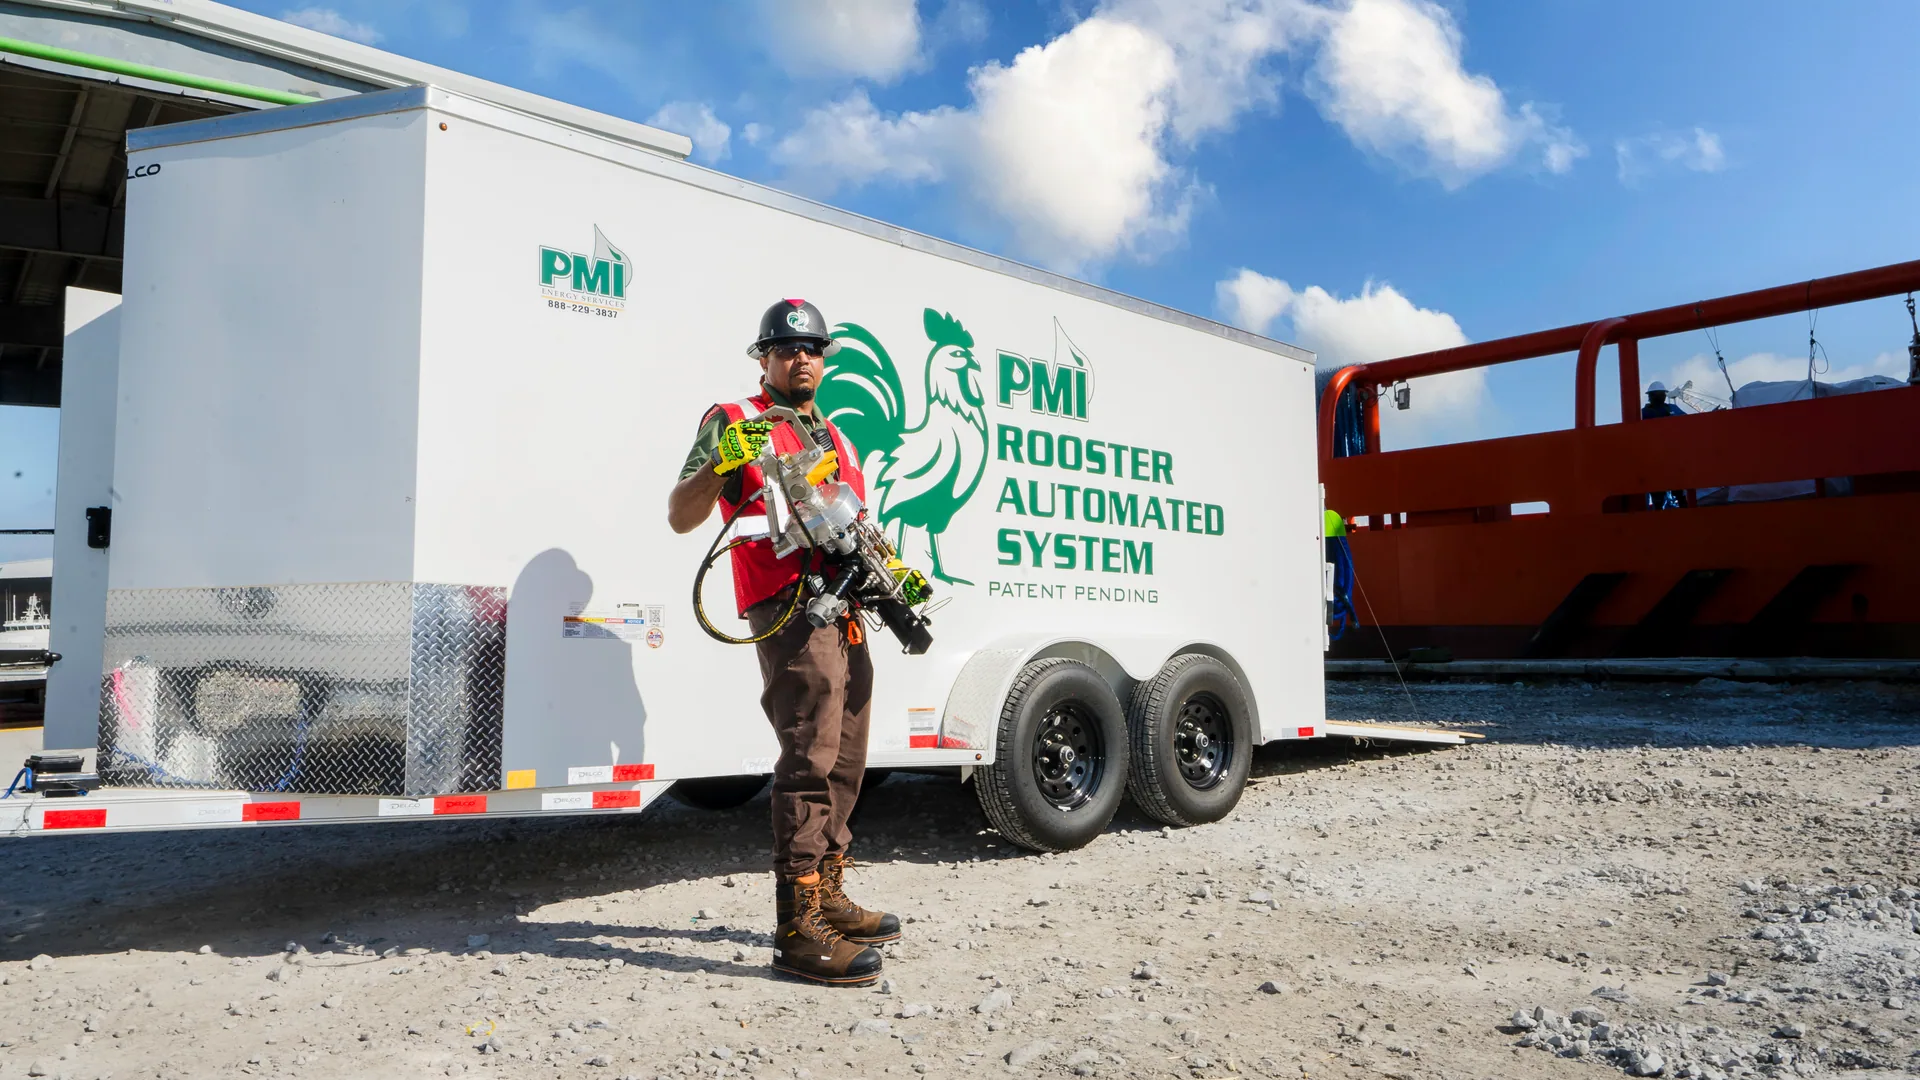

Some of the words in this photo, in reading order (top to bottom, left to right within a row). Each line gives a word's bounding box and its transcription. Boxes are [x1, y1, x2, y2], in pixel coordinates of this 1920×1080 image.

[542, 288, 578, 300] ENERGY
[582, 295, 625, 308] SERVICES
[548, 299, 618, 318] 888-229-3837
[997, 423, 1174, 485] ROOSTER
[996, 476, 1224, 536] AUTOMATED
[997, 527, 1154, 576] SYSTEM
[989, 581, 1067, 600] PATENT
[1074, 586, 1159, 603] PENDING
